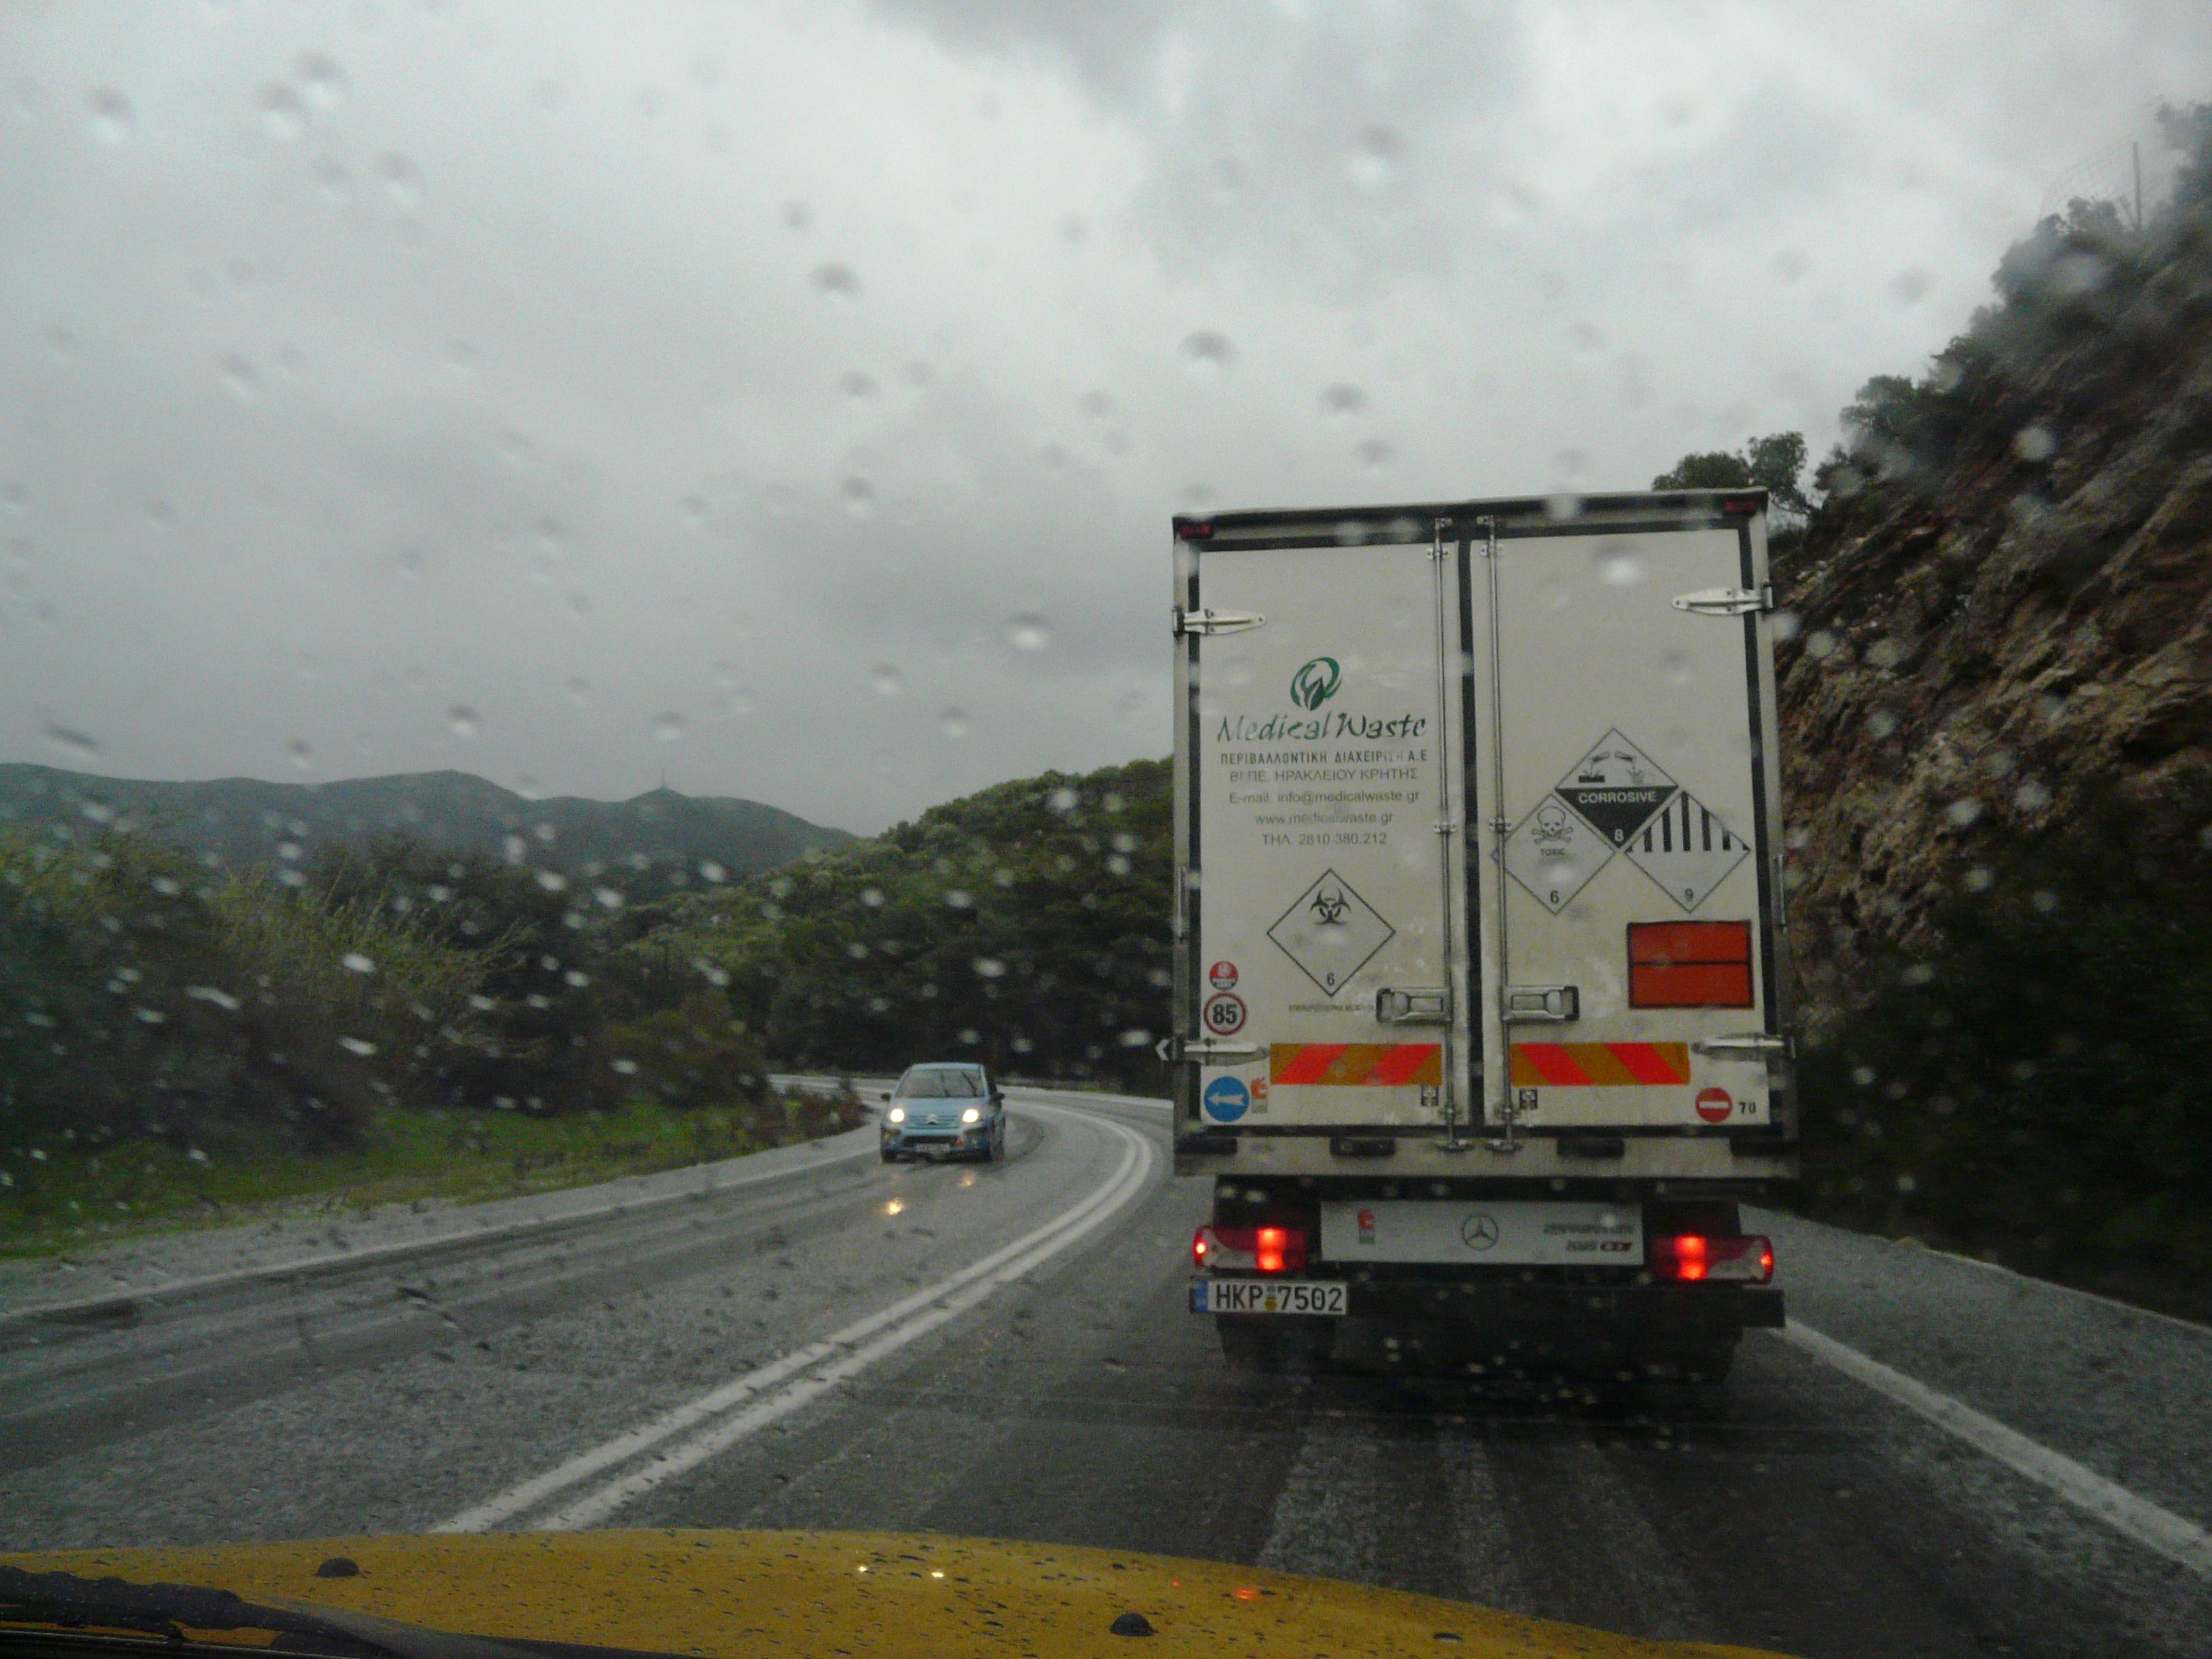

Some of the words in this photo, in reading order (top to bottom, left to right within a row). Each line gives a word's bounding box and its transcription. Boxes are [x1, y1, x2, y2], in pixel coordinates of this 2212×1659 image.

[1217, 712, 1331, 742] Medical
[1336, 712, 1427, 739] Waste
[1221, 751, 1326, 765] ΠΕΡΙΒΑΛΛΟΝΤΙΚΗ
[1275, 769, 1356, 781] ΗΡΑΚΛΕΙΟΥ
[1360, 767, 1418, 780] ΚΡΗΤΗΣ
[1578, 790, 1657, 804] CORROSIVE
[1298, 833, 1331, 846] 2810
[1614, 828, 1624, 842] 8
[1540, 848, 1566, 856] TOXIC
[1549, 889, 1559, 905] 6
[1685, 888, 1694, 903] 9
[1326, 972, 1335, 987] 6
[1212, 1003, 1238, 1025] 85
[1739, 1101, 1757, 1115] 70
[1216, 1284, 1264, 1309] HKP
[1277, 1285, 1343, 1312] 7502
